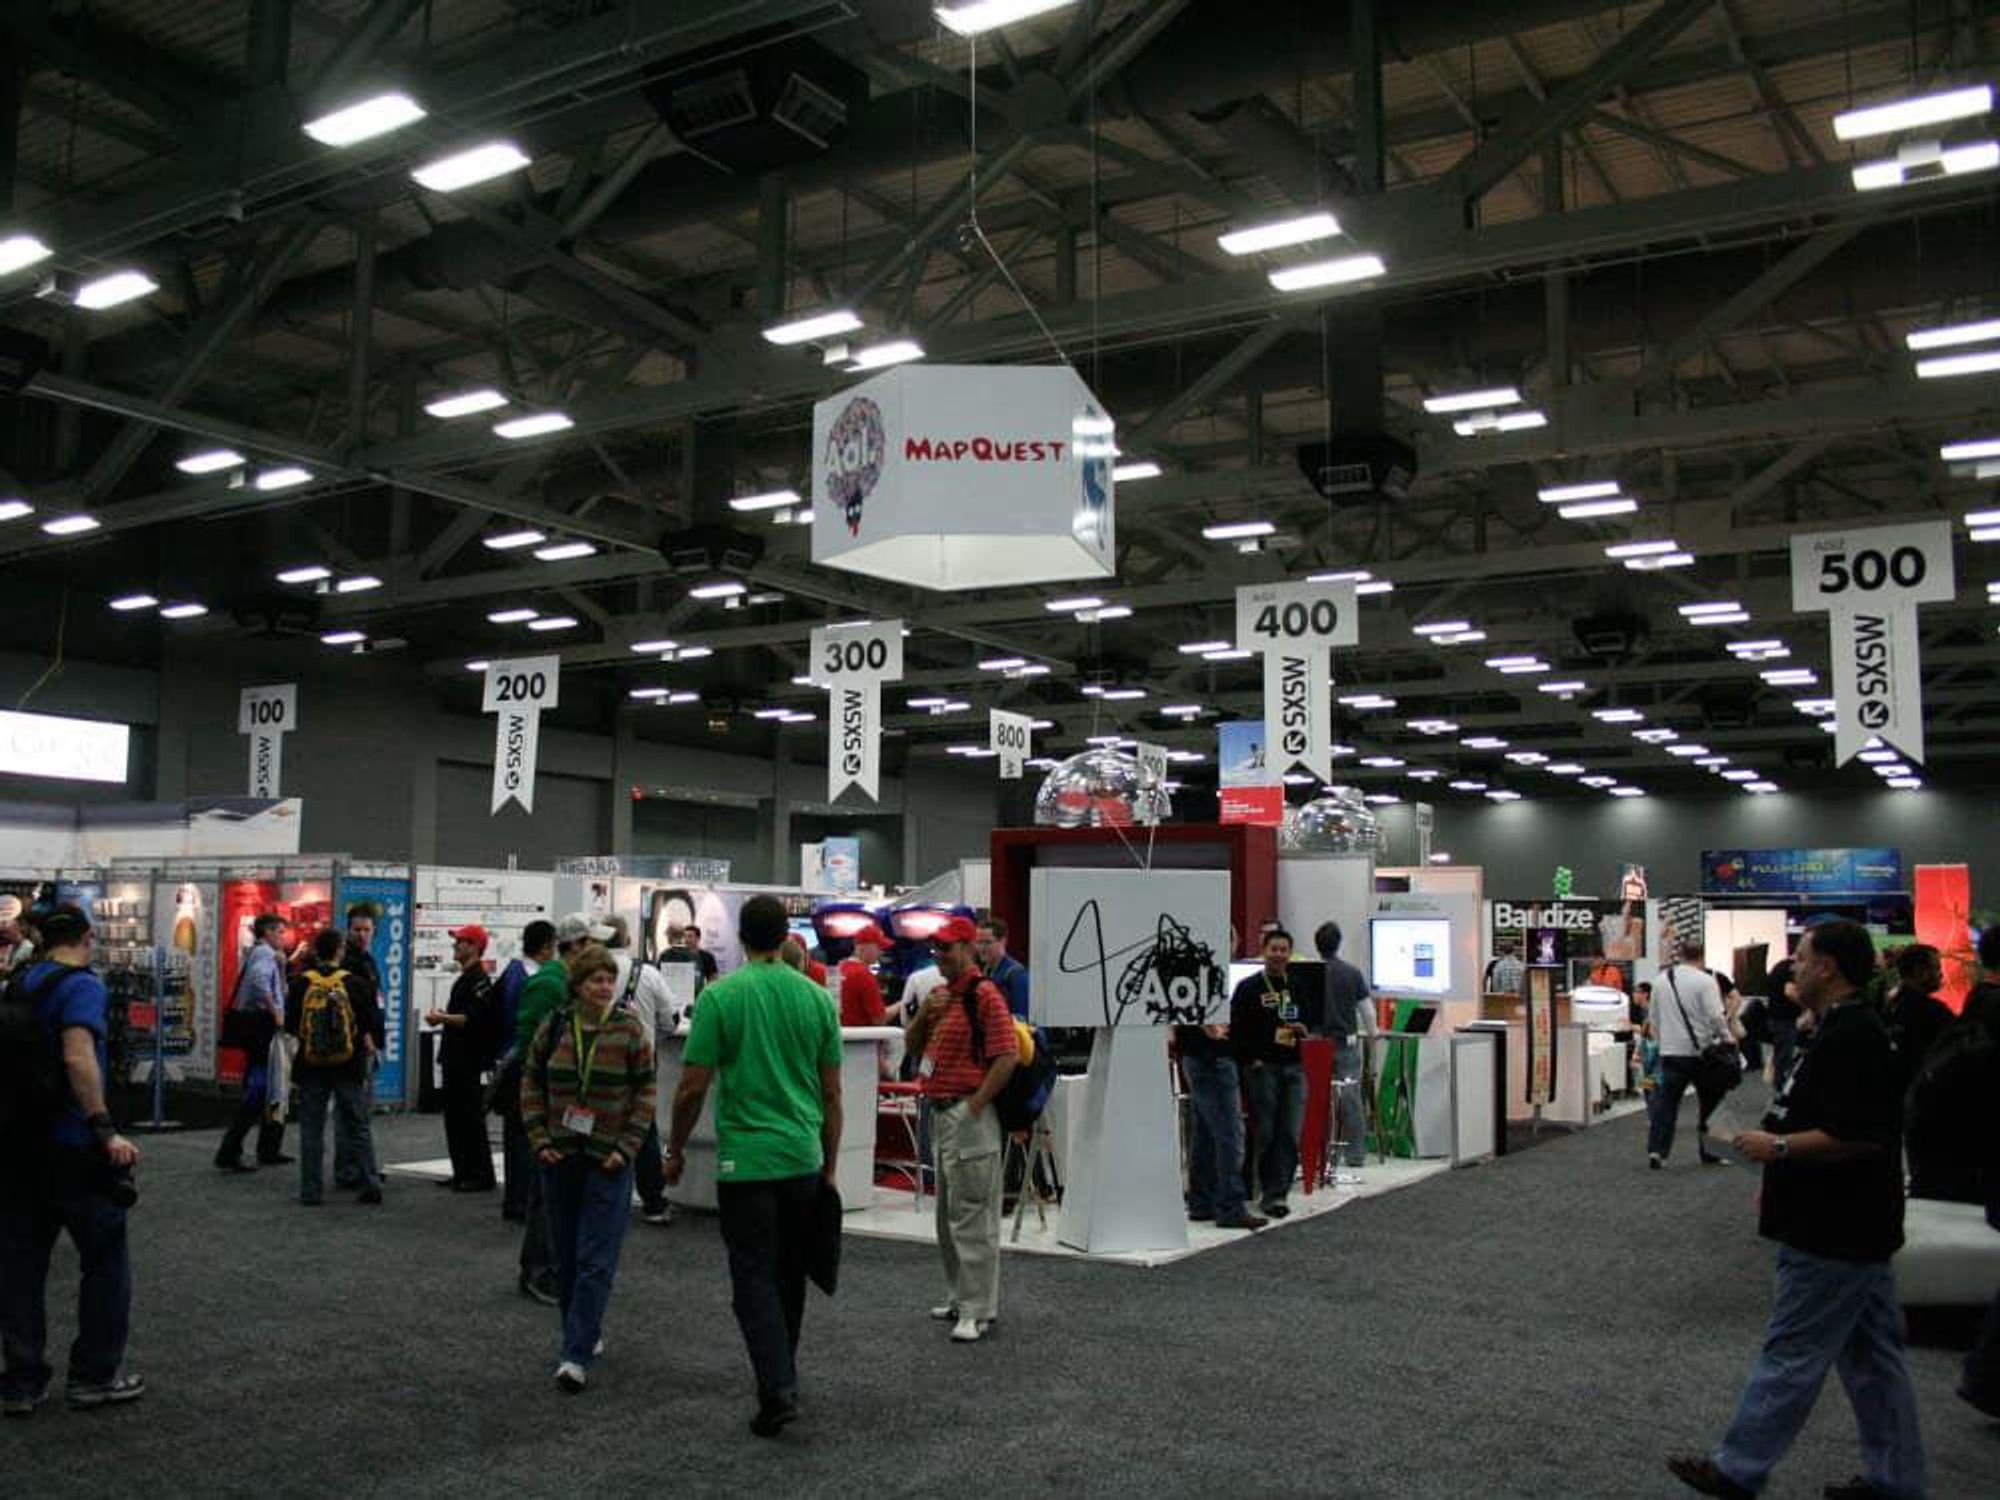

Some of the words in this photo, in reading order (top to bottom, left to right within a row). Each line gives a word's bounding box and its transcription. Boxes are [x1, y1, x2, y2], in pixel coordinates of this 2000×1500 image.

[1819, 546, 1927, 593] 500
[1254, 599, 1338, 638] 400
[824, 638, 887, 673] 300
[1854, 614, 1888, 696] SXSW
[496, 672, 546, 701] 200
[1281, 656, 1307, 727] SXSW
[250, 699, 284, 724] 100
[844, 690, 862, 751] SXSW
[507, 714, 524, 769] SXSW
[997, 723, 1025, 749] 800
[384, 898, 404, 1061] mimobot
